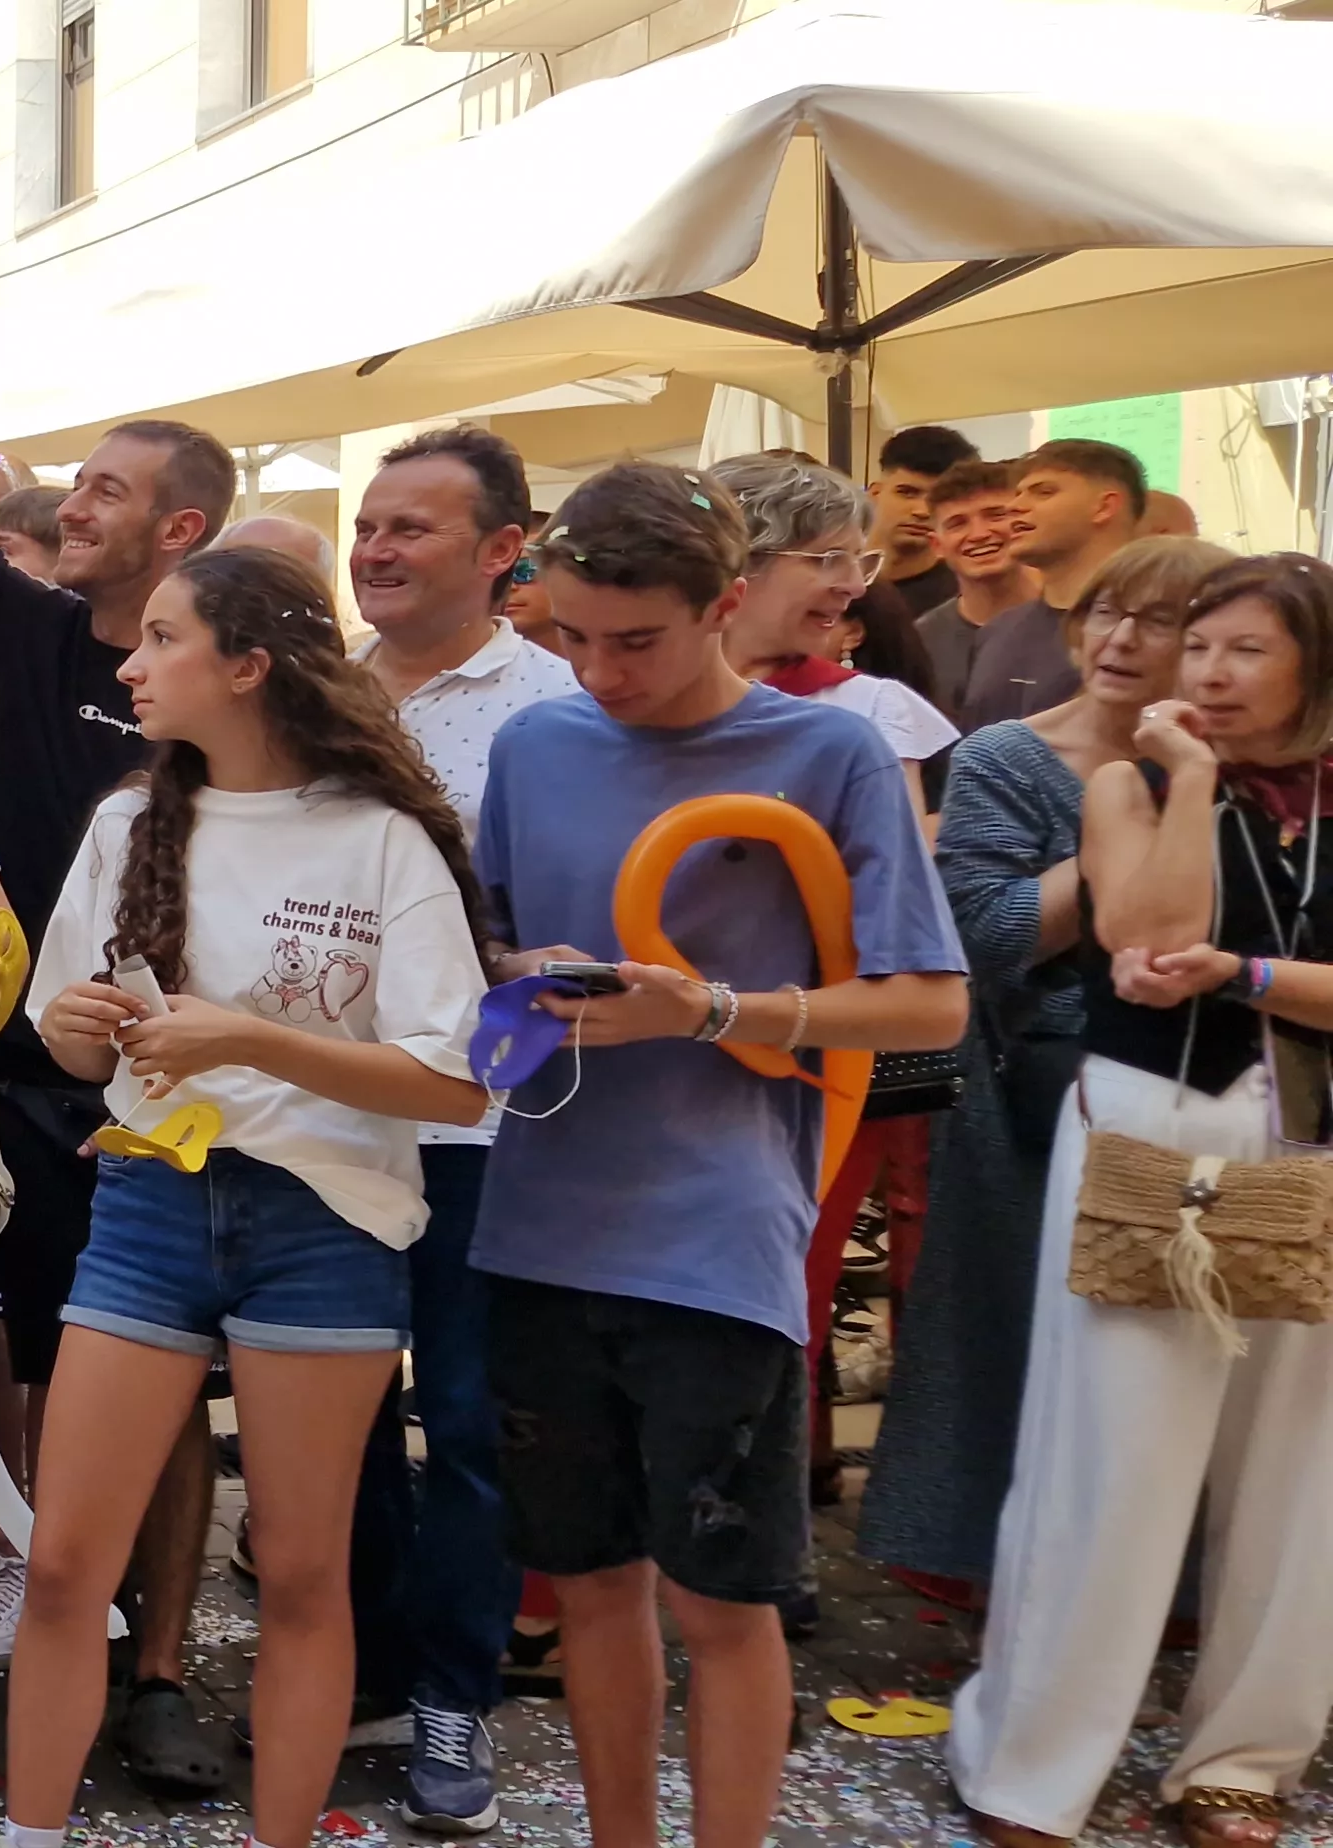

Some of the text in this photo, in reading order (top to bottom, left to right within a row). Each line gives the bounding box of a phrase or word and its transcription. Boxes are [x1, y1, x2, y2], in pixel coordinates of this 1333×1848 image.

[79, 704, 142, 736] Champi
[262, 912, 325, 936] charms
[329, 921, 342, 938] &
[284, 897, 380, 926] trend alert:
